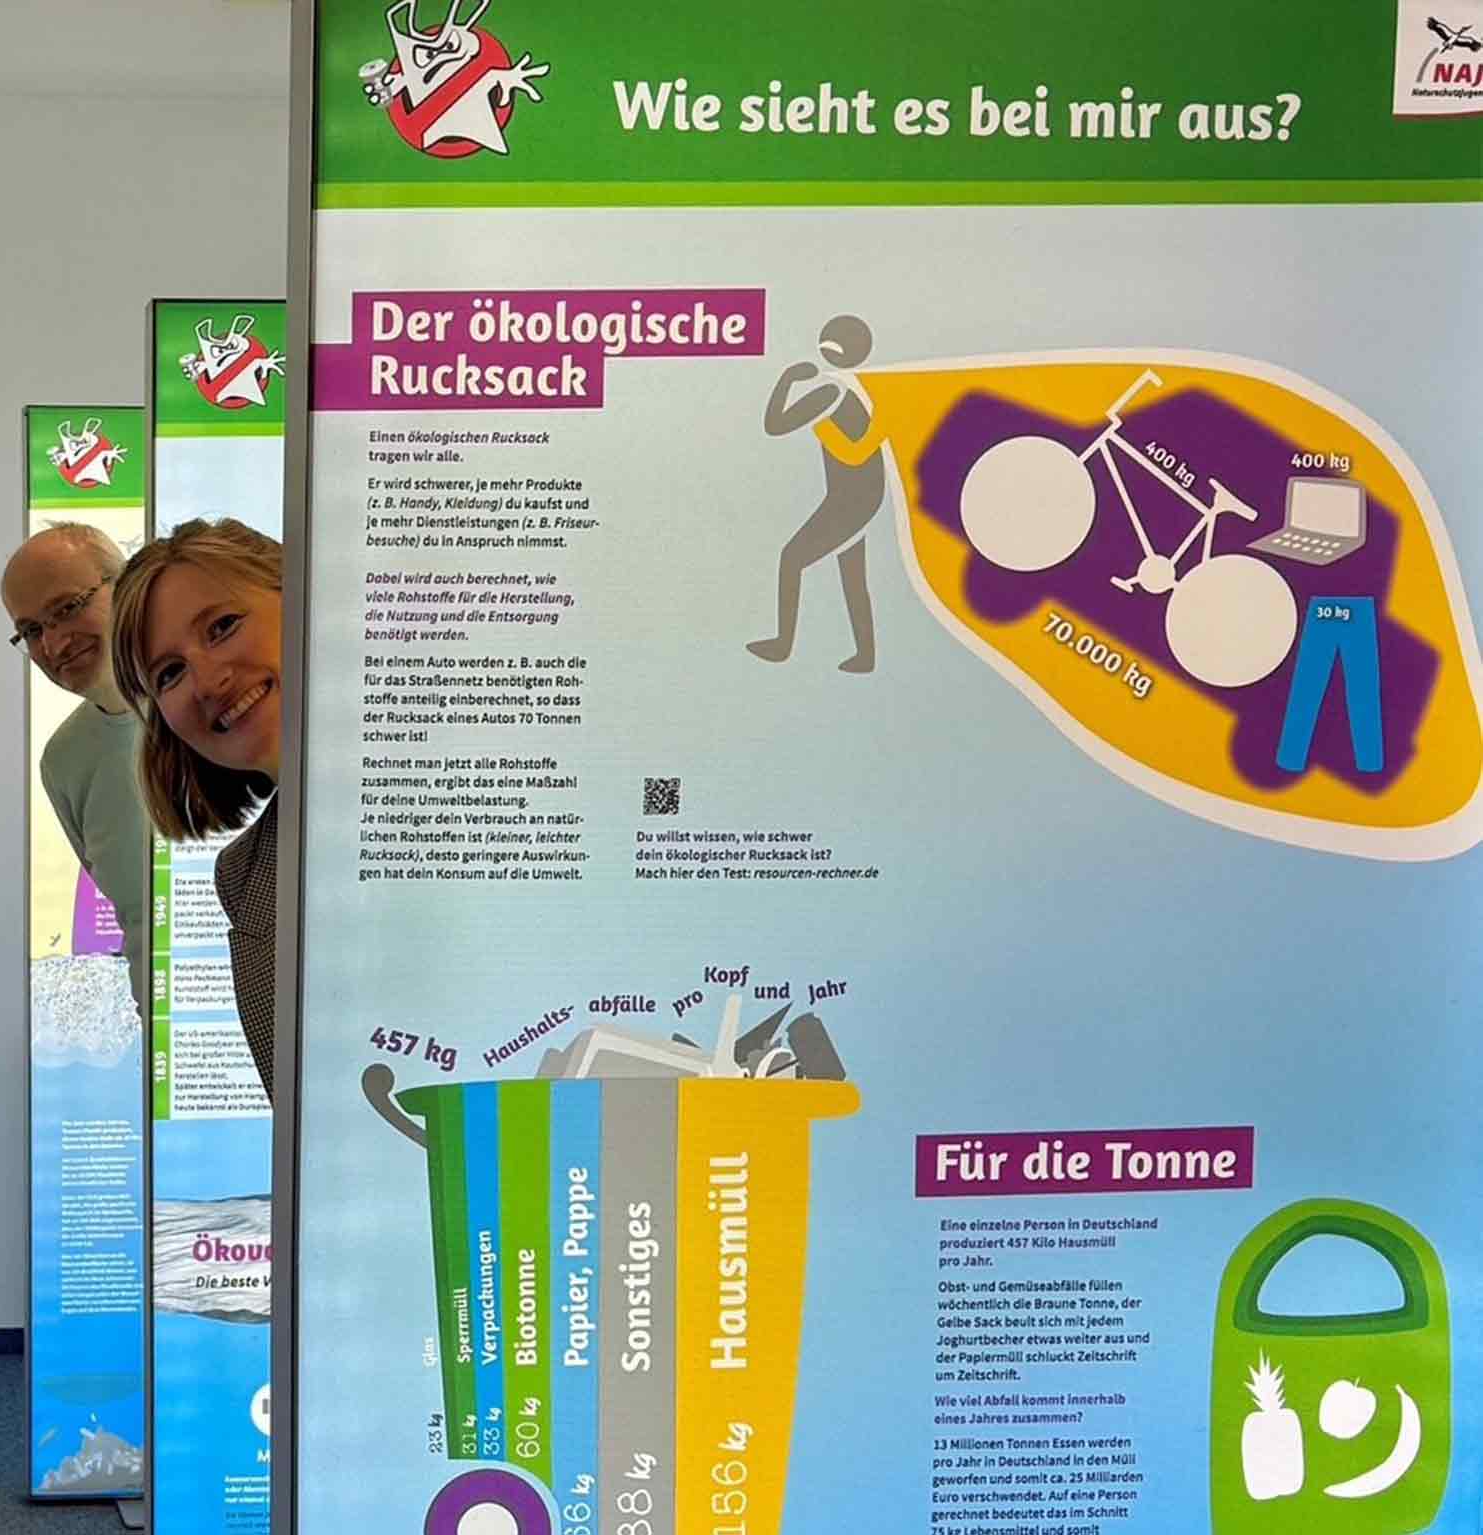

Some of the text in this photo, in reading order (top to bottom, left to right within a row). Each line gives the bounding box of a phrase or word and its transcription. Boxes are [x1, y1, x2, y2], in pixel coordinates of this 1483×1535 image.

[613, 78, 1300, 140] Wie sieht es bei mir aus?
[373, 299, 745, 354] Der ökologische
[372, 354, 586, 396] Rucksack
[370, 431, 549, 445] Einen ökologischen Rucksack
[1145, 441, 1195, 488] 400 kg
[1291, 453, 1350, 472] 400 kg
[1317, 606, 1350, 620] 30 kg
[1044, 612, 1152, 697] 70.000 kg
[637, 830, 813, 844] Du willst wissen, wie schwer
[636, 867, 879, 879] Mach hier den Test: resourcen-rechner.de
[483, 966, 848, 1068] Haushalts- abfälle pro Kopf und Jahr
[370, 1027, 457, 1071] 457 kg
[937, 1141, 1235, 1180] Für die Tonne
[941, 1218, 1158, 1231] Eine einzelne Person in Deutschland
[196, 1274, 259, 1288] Die beste
[564, 1166, 595, 1367] Papier, Pappe
[708, 1151, 749, 1369] Hausmüll
[480, 1230, 500, 1366] Verpackungen
[516, 1249, 537, 1366] Biotonne
[621, 1201, 659, 1372] Sonstiges
[454, 1288, 472, 1363] Sperrmüll
[483, 1407, 502, 1455] 33 kg
[516, 1397, 542, 1458] 60 kg
[717, 1422, 754, 1452] kg
